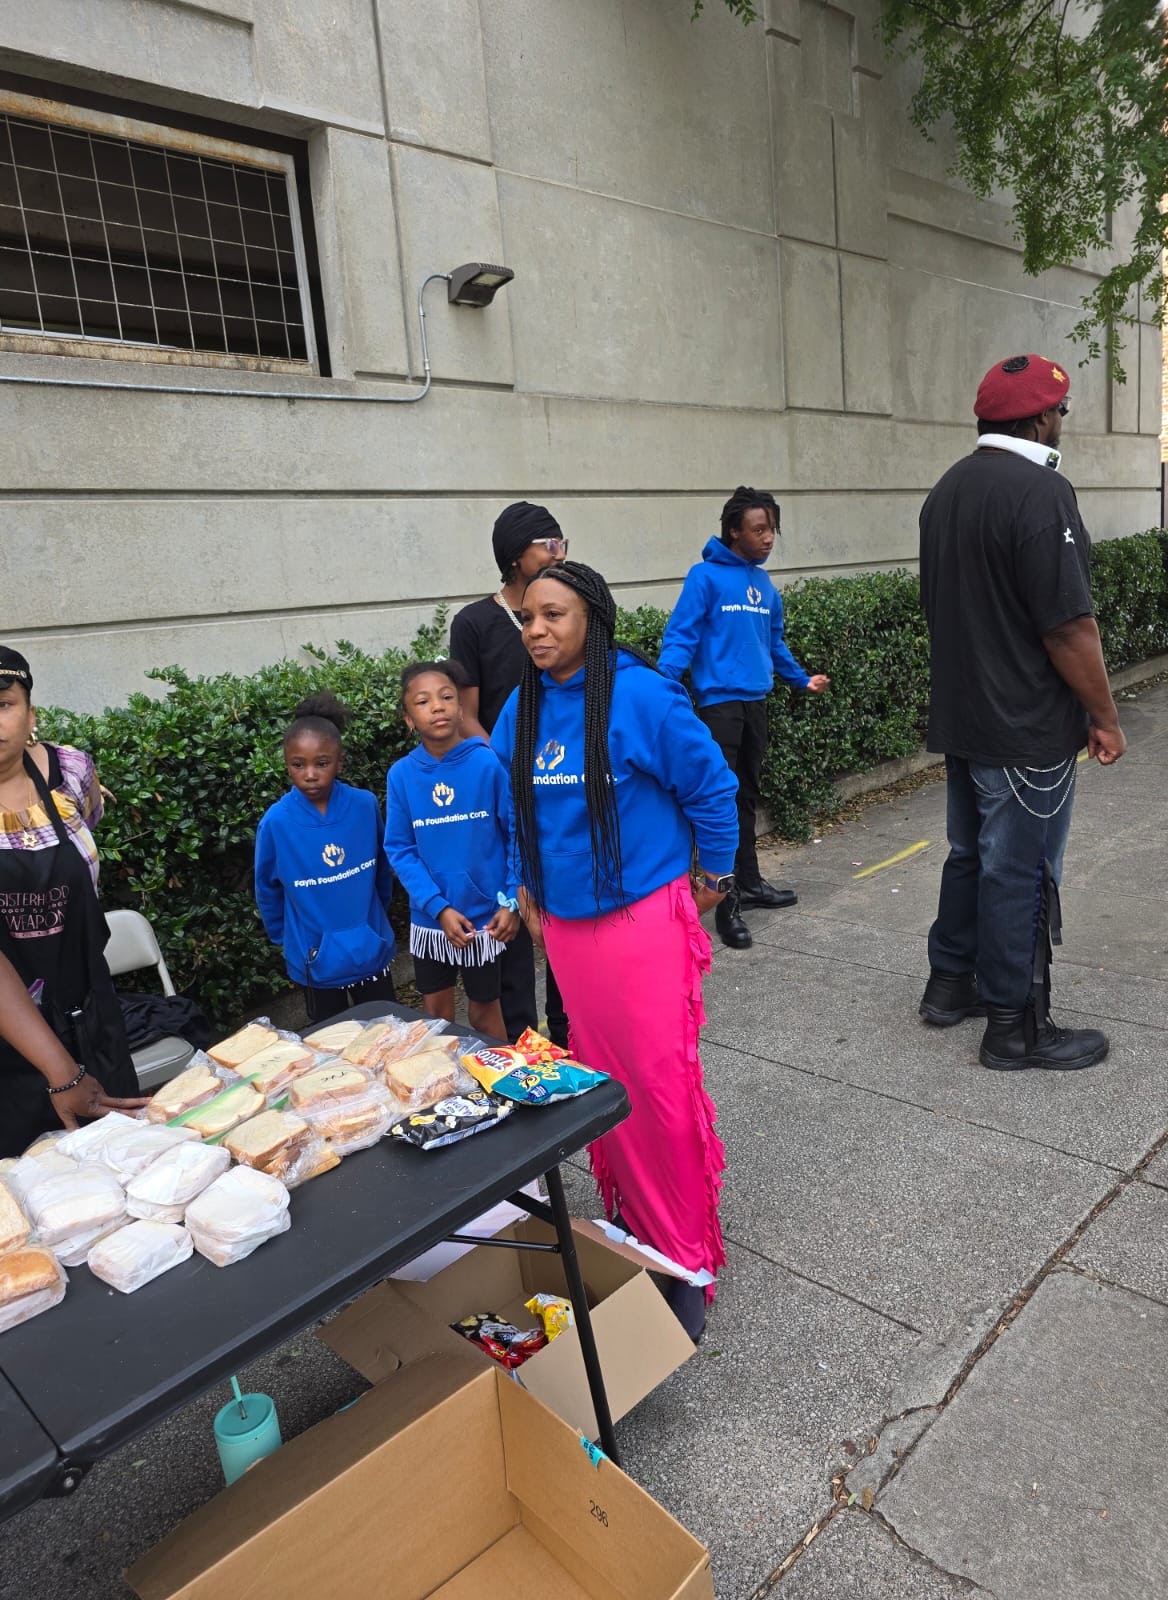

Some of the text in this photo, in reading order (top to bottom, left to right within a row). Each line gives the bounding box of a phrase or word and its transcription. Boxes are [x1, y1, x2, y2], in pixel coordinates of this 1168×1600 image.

[425, 813, 469, 826] Foundation
[469, 810, 490, 819] Corp.
[317, 866, 361, 885] Foundation
[474, 1049, 515, 1072] Fritos
